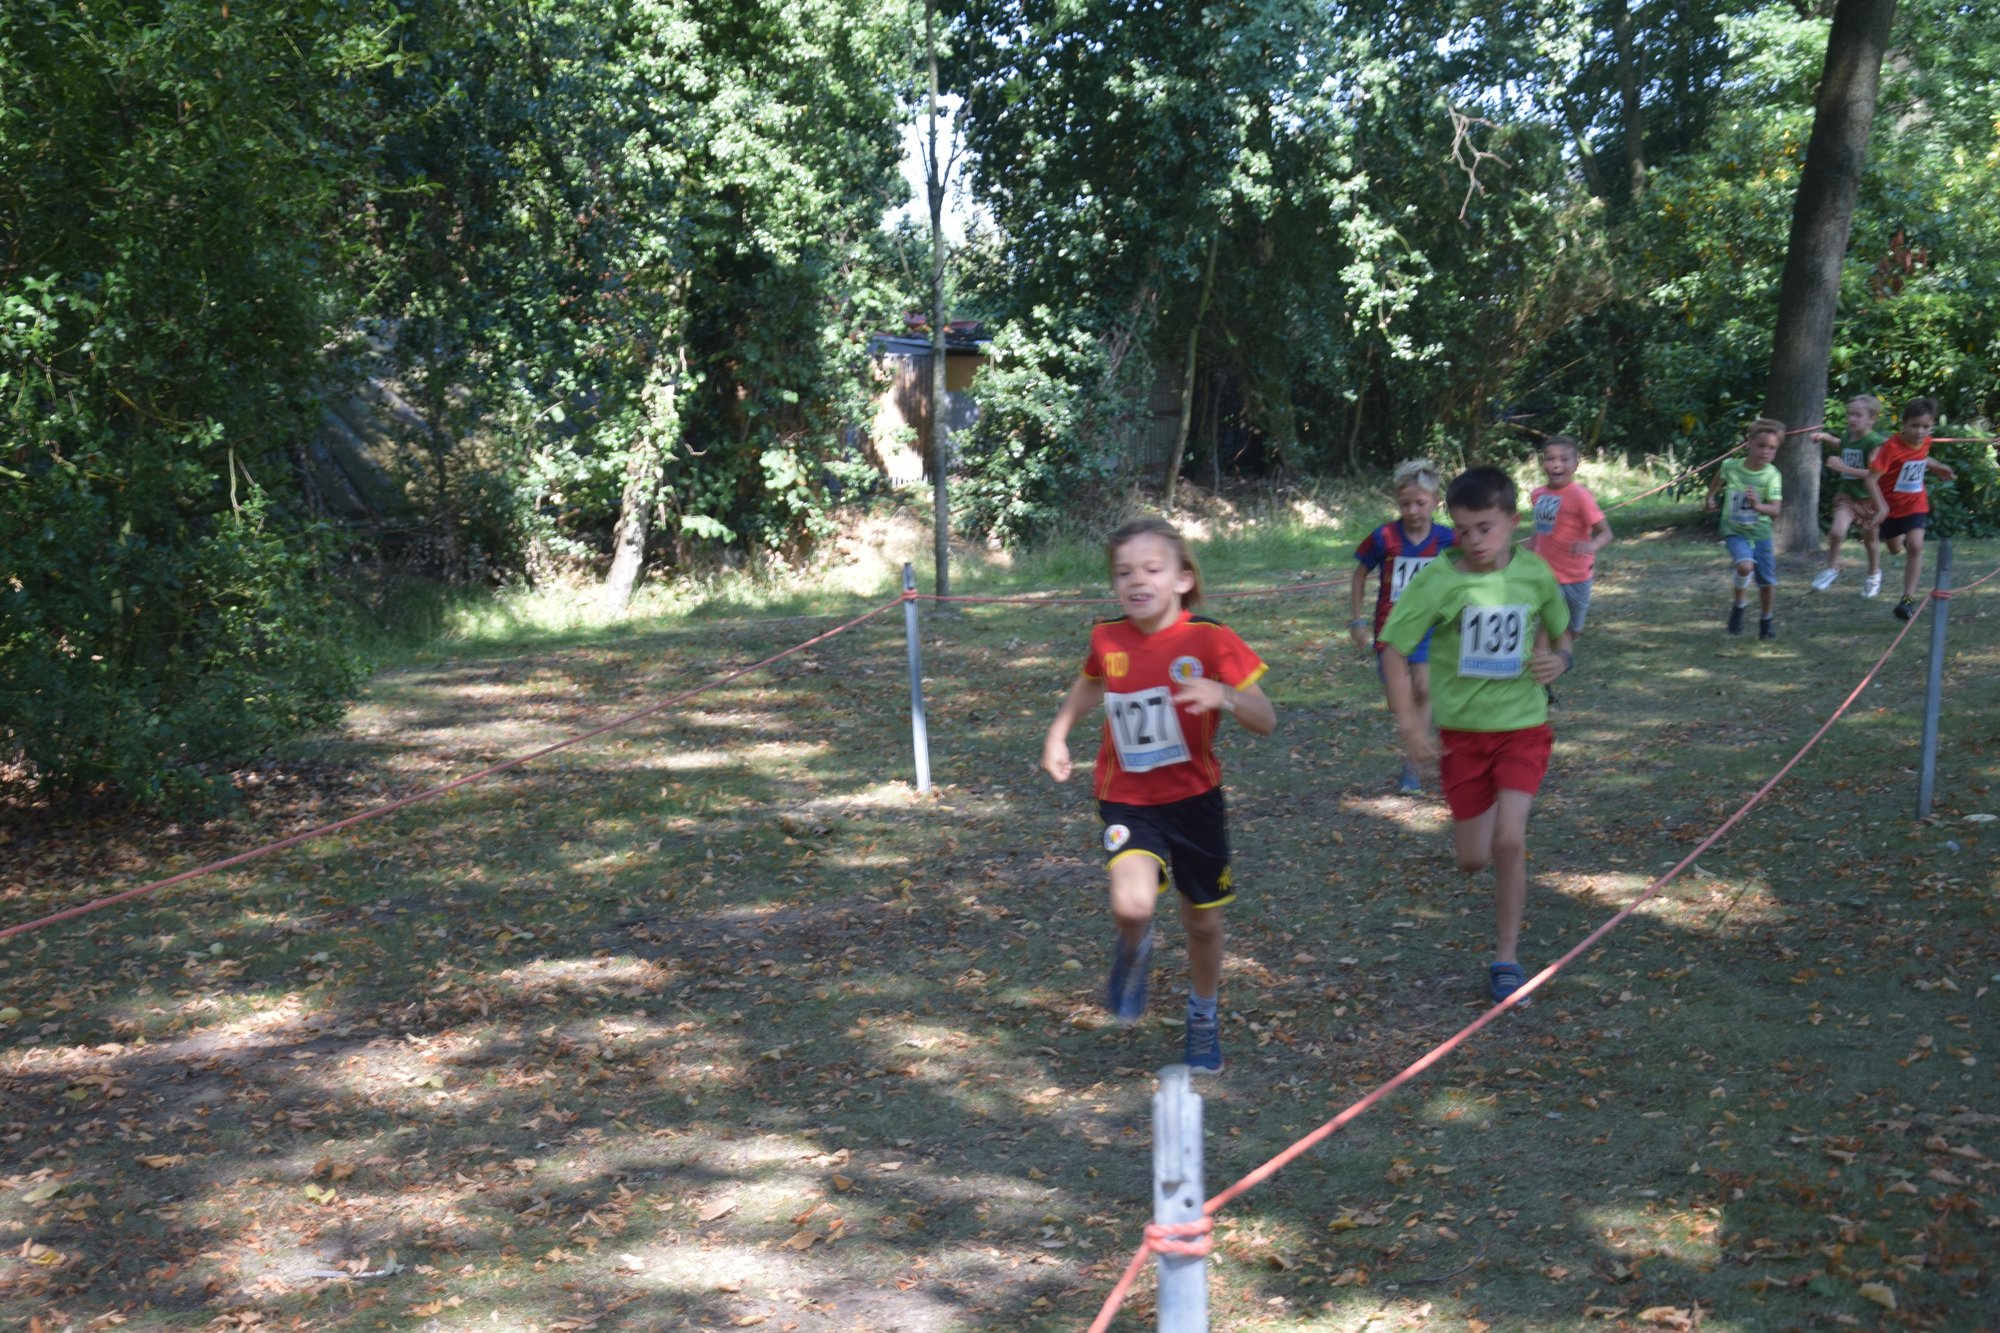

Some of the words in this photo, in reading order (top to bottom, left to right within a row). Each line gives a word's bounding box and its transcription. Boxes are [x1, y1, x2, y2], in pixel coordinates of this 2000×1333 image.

[1467, 610, 1521, 656] 139
[1104, 651, 1129, 677] 10
[1113, 695, 1168, 746] 127
